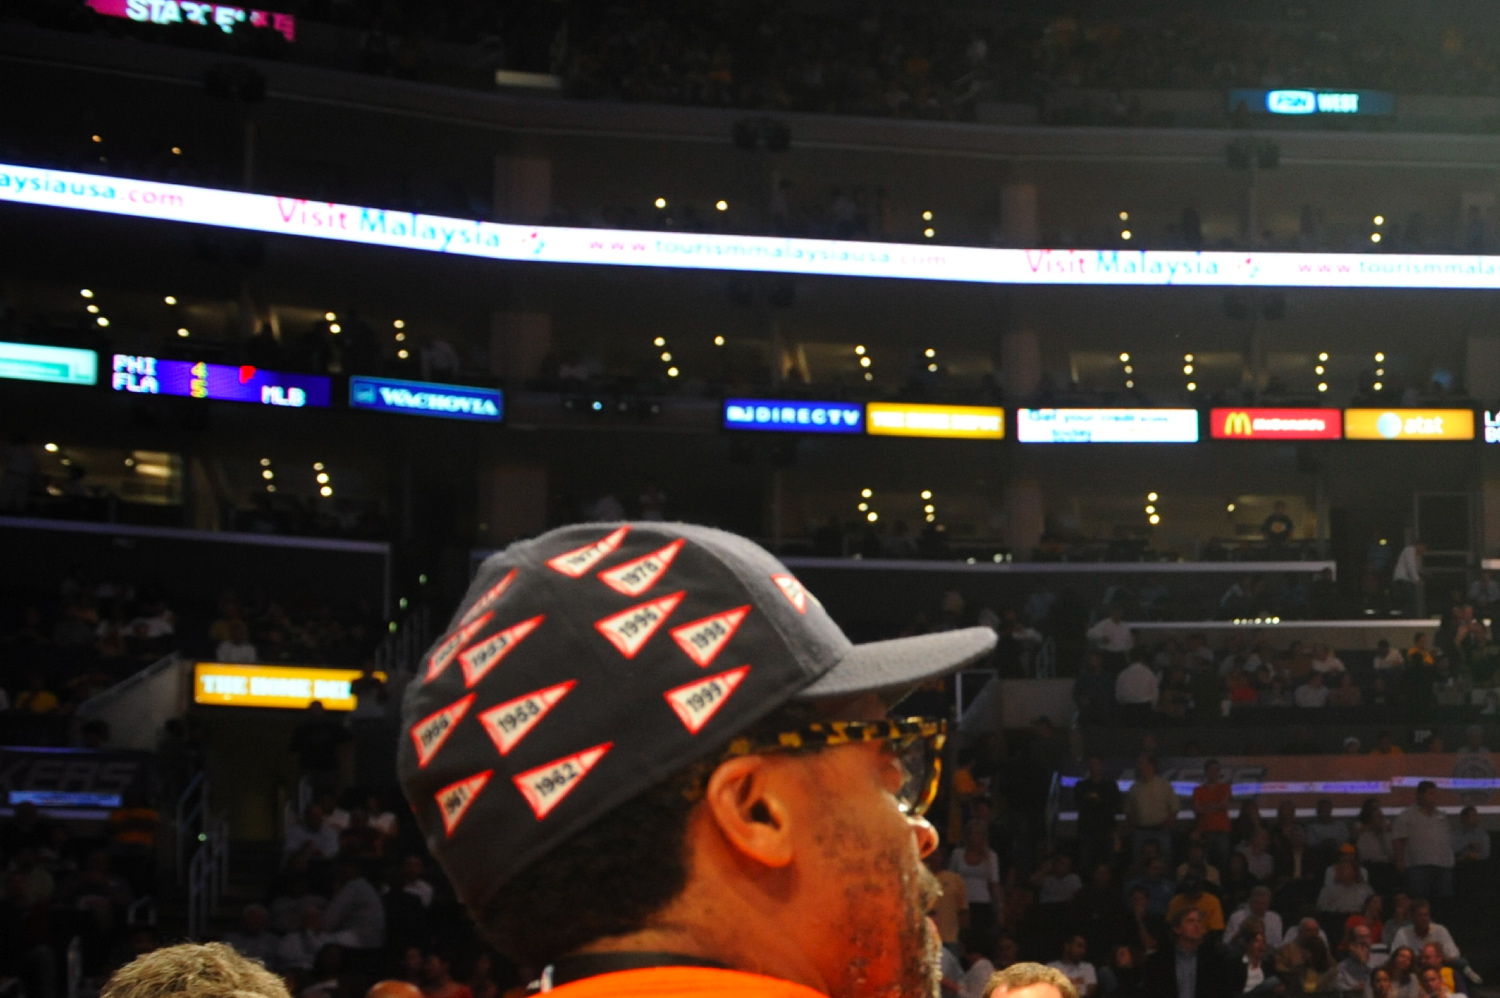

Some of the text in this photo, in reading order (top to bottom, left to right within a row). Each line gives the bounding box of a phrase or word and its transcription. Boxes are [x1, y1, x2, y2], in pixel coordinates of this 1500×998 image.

[275, 197, 348, 230] Visit
[357, 207, 501, 252] Malaysia
[1024, 250, 1086, 274] Visit
[1095, 250, 1220, 285] Malaysia
[112, 354, 157, 376] PHI
[112, 372, 159, 394] FLA
[261, 385, 306, 407] MLB
[378, 387, 499, 416] WACHOVIA
[755, 406, 861, 426] DIRECTV
[619, 607, 659, 639] 1996
[690, 621, 727, 649] 1998
[686, 683, 723, 713] 1999
[498, 699, 540, 734] 1958
[534, 762, 577, 797] 1962
